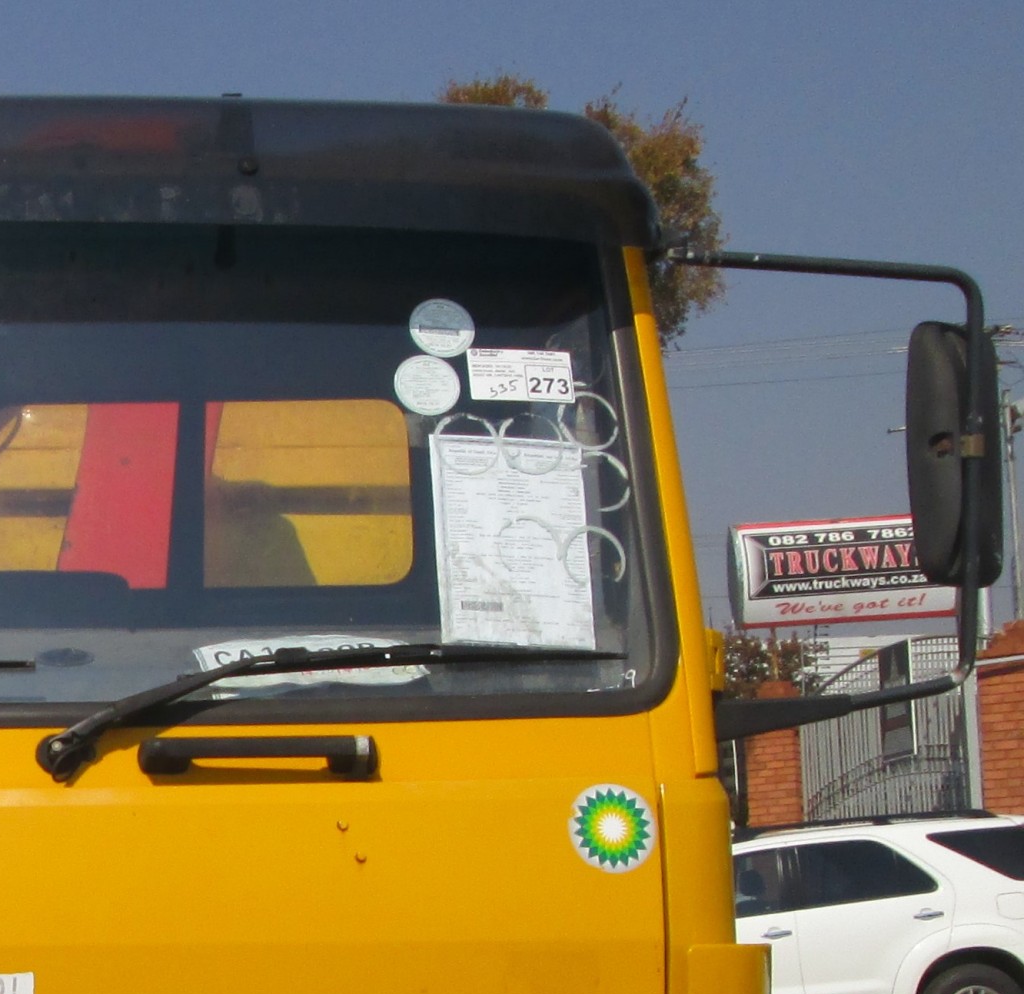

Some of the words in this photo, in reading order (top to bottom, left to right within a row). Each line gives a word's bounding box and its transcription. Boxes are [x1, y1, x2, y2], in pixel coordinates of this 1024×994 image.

[528, 377, 569, 395] 273
[769, 534, 808, 546] 082
[815, 531, 855, 543] 786
[769, 543, 919, 576] TRUCKWAY
[776, 601, 844, 615] We've
[852, 599, 889, 613] got
[898, 593, 926, 607] it!
